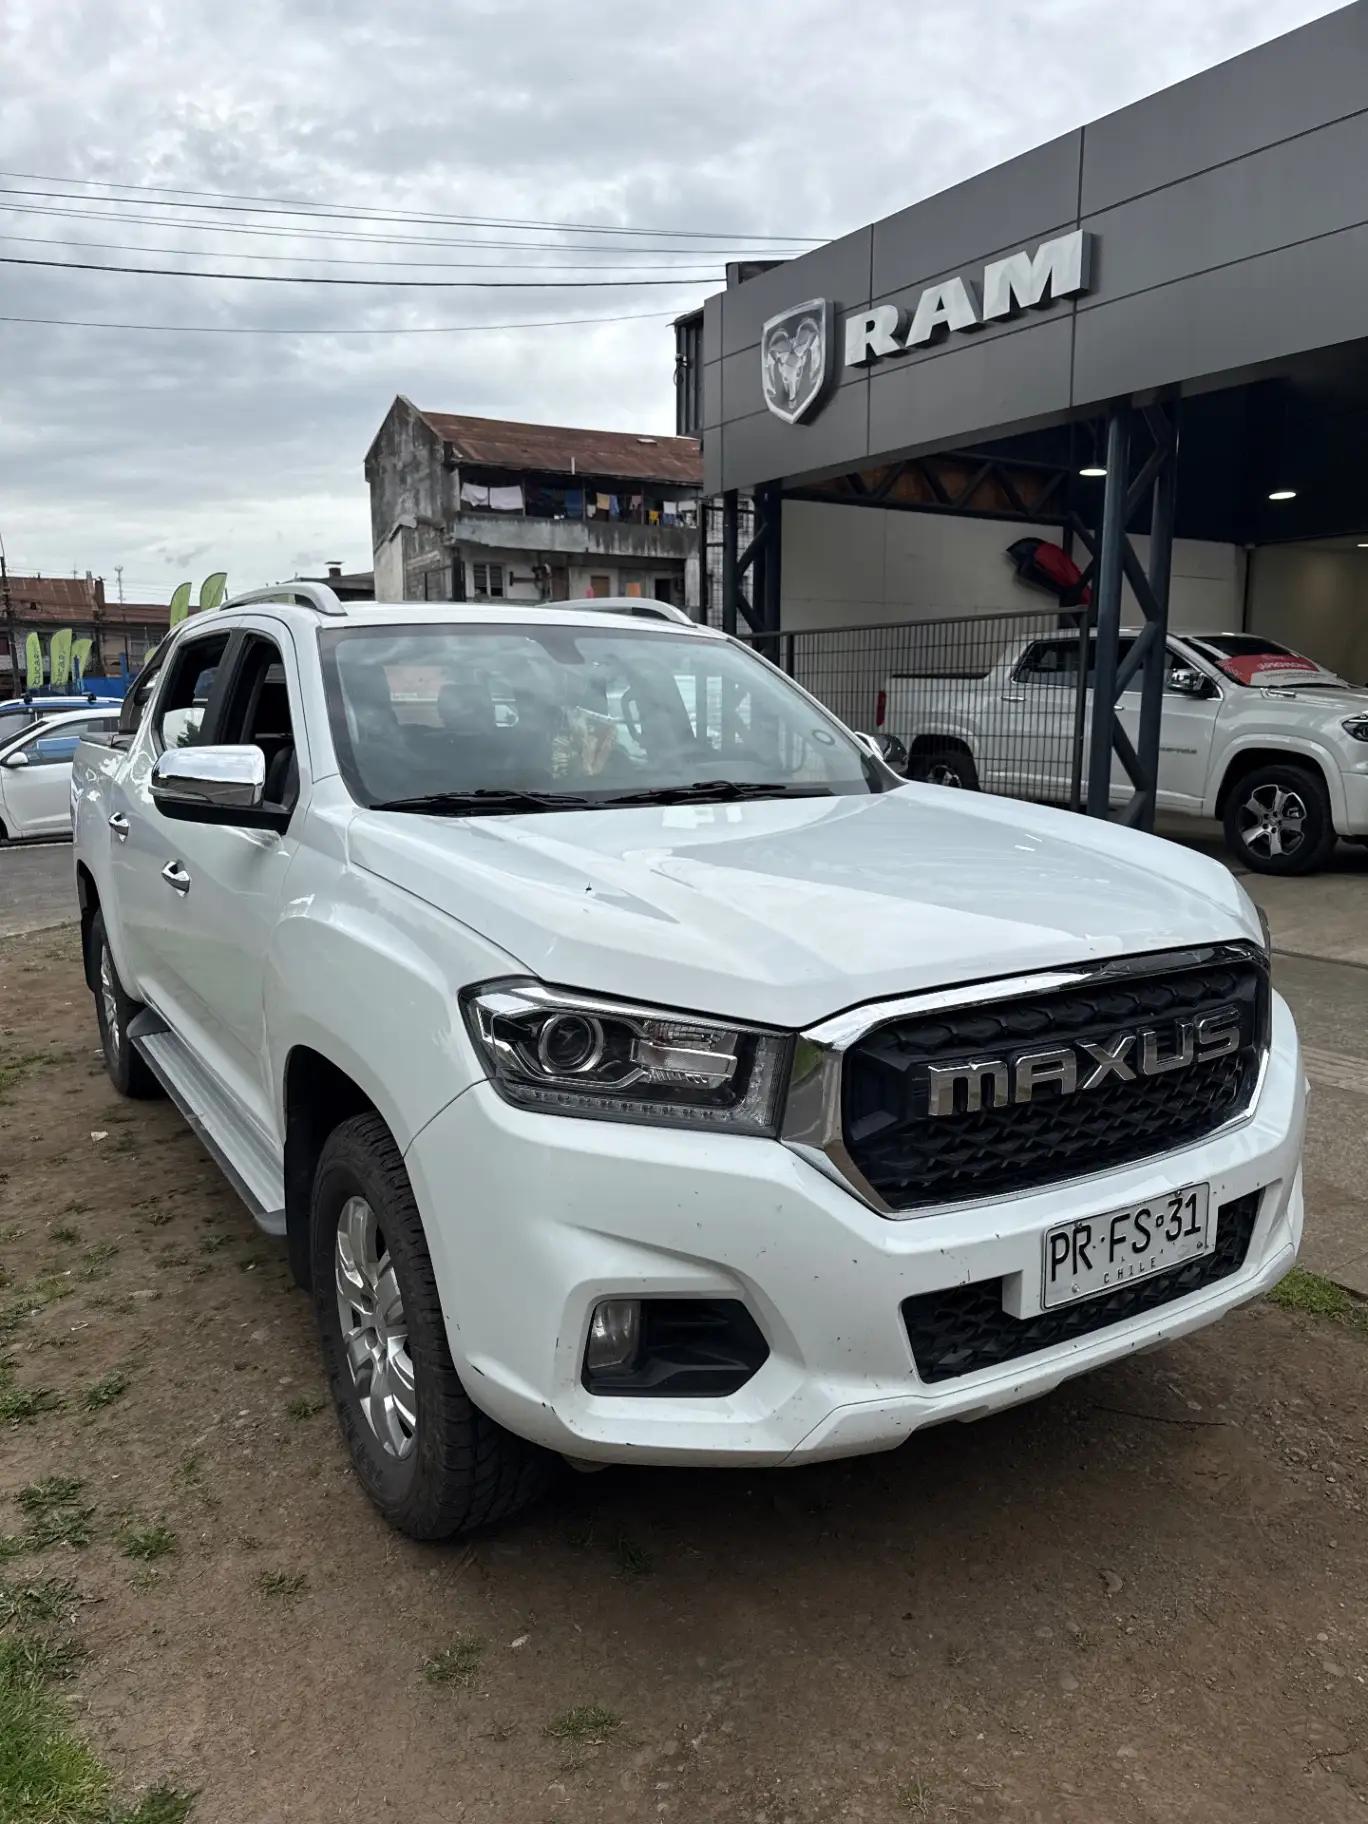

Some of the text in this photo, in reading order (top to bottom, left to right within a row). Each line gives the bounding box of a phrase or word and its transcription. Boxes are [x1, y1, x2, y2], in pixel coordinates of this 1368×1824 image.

[844, 229, 1086, 367] RAM
[928, 1005, 1240, 1116] MAXUS
[1103, 1256, 1157, 1284] CHILE
